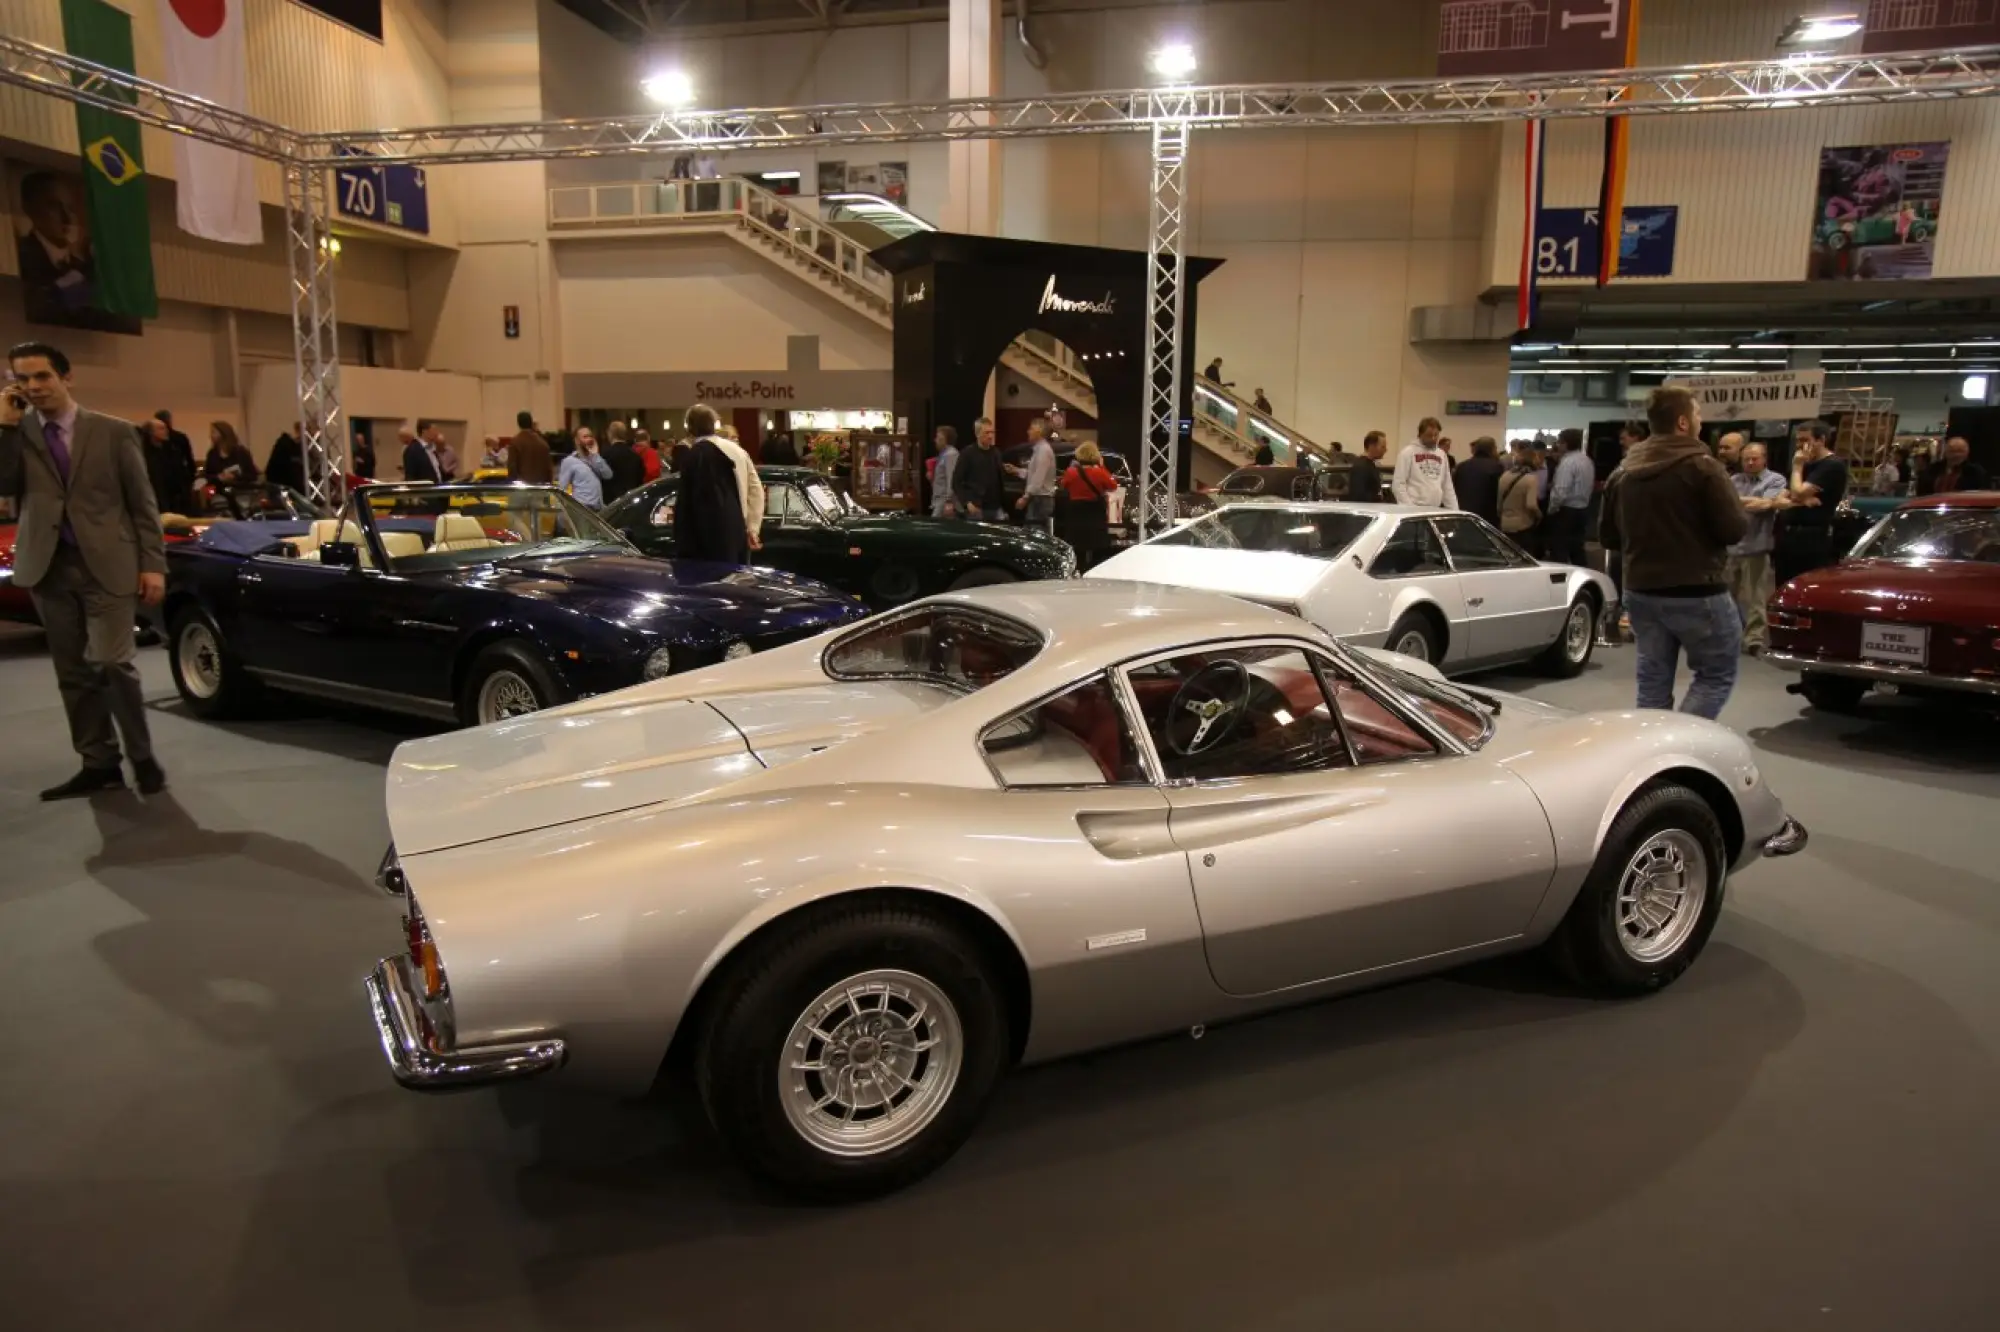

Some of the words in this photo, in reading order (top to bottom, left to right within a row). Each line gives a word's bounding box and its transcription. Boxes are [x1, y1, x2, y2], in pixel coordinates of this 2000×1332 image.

[341, 172, 376, 216] 7.0
[1537, 236, 1580, 274] 8.1
[695, 380, 795, 400] Snack-Point
[1702, 387, 1729, 404] AND
[1732, 384, 1780, 401] FINISH
[1784, 383, 1821, 400] LINE
[1881, 632, 1906, 643] THE
[1865, 641, 1921, 655] GALLERY
